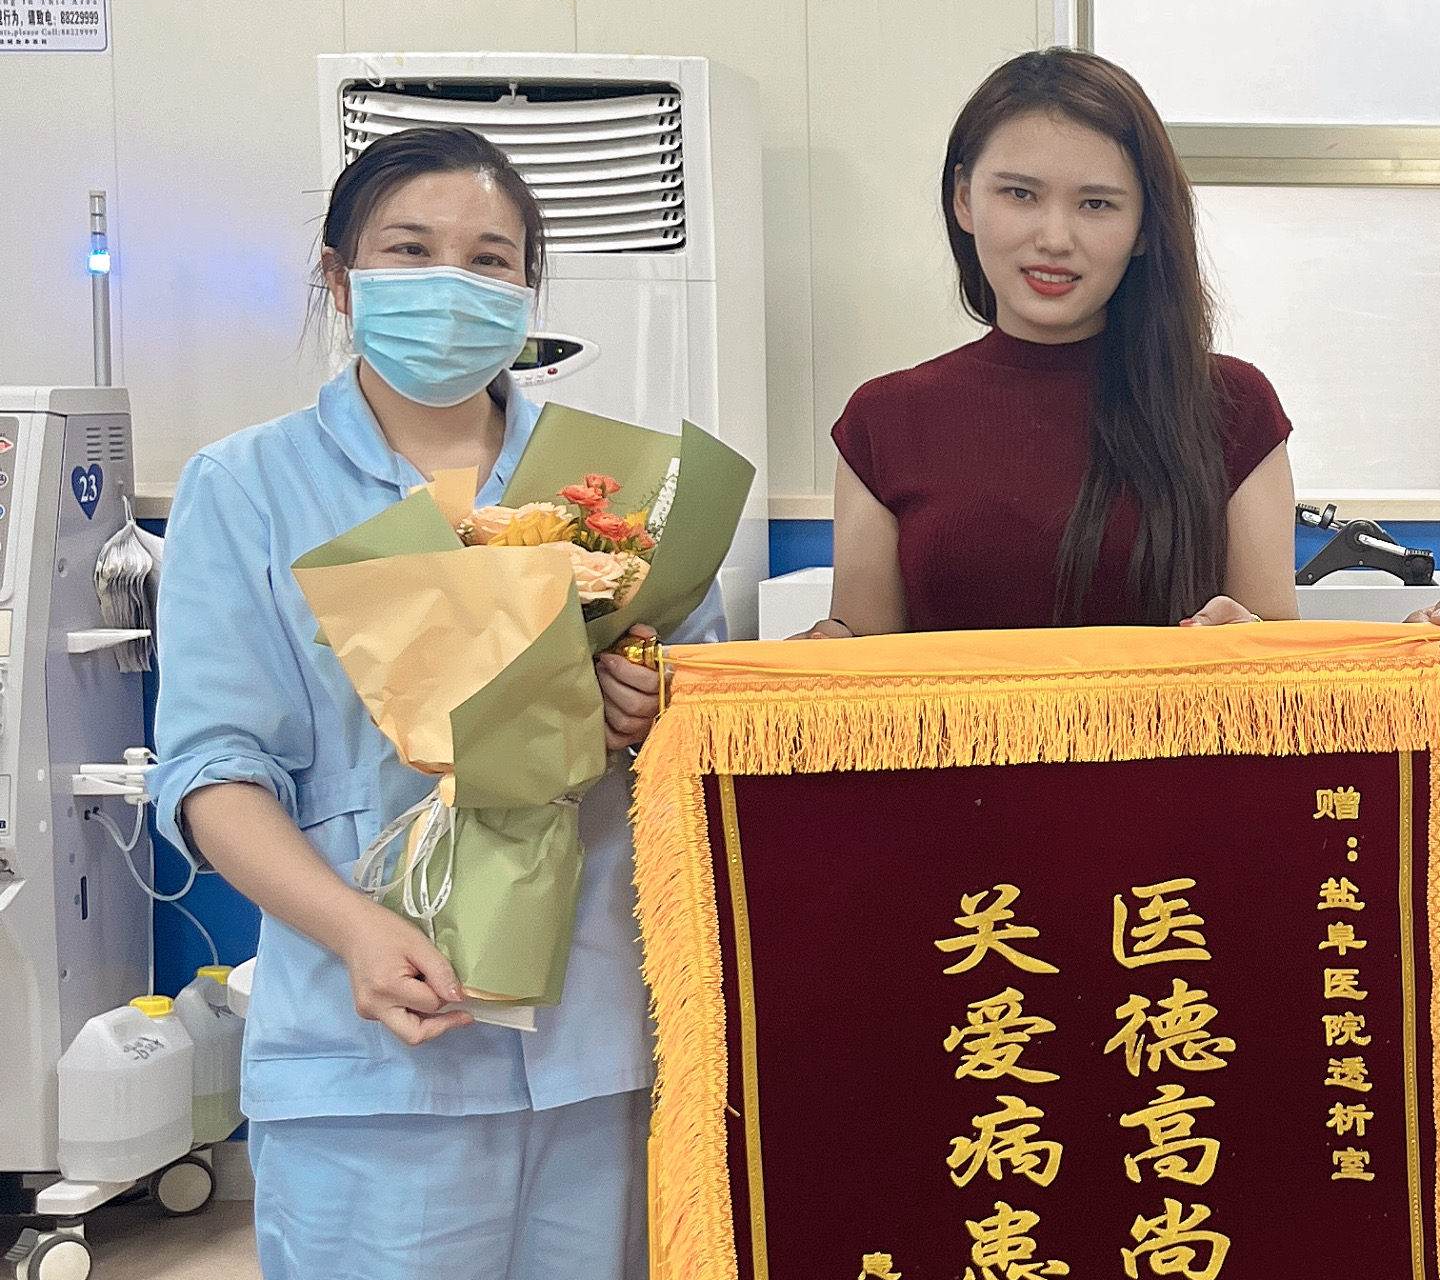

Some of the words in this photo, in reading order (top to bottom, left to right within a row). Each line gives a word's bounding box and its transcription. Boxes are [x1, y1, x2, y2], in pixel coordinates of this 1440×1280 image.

[79, 474, 98, 503] 23
[1312, 785, 1376, 1183] 赠：盐阜医院透析室
